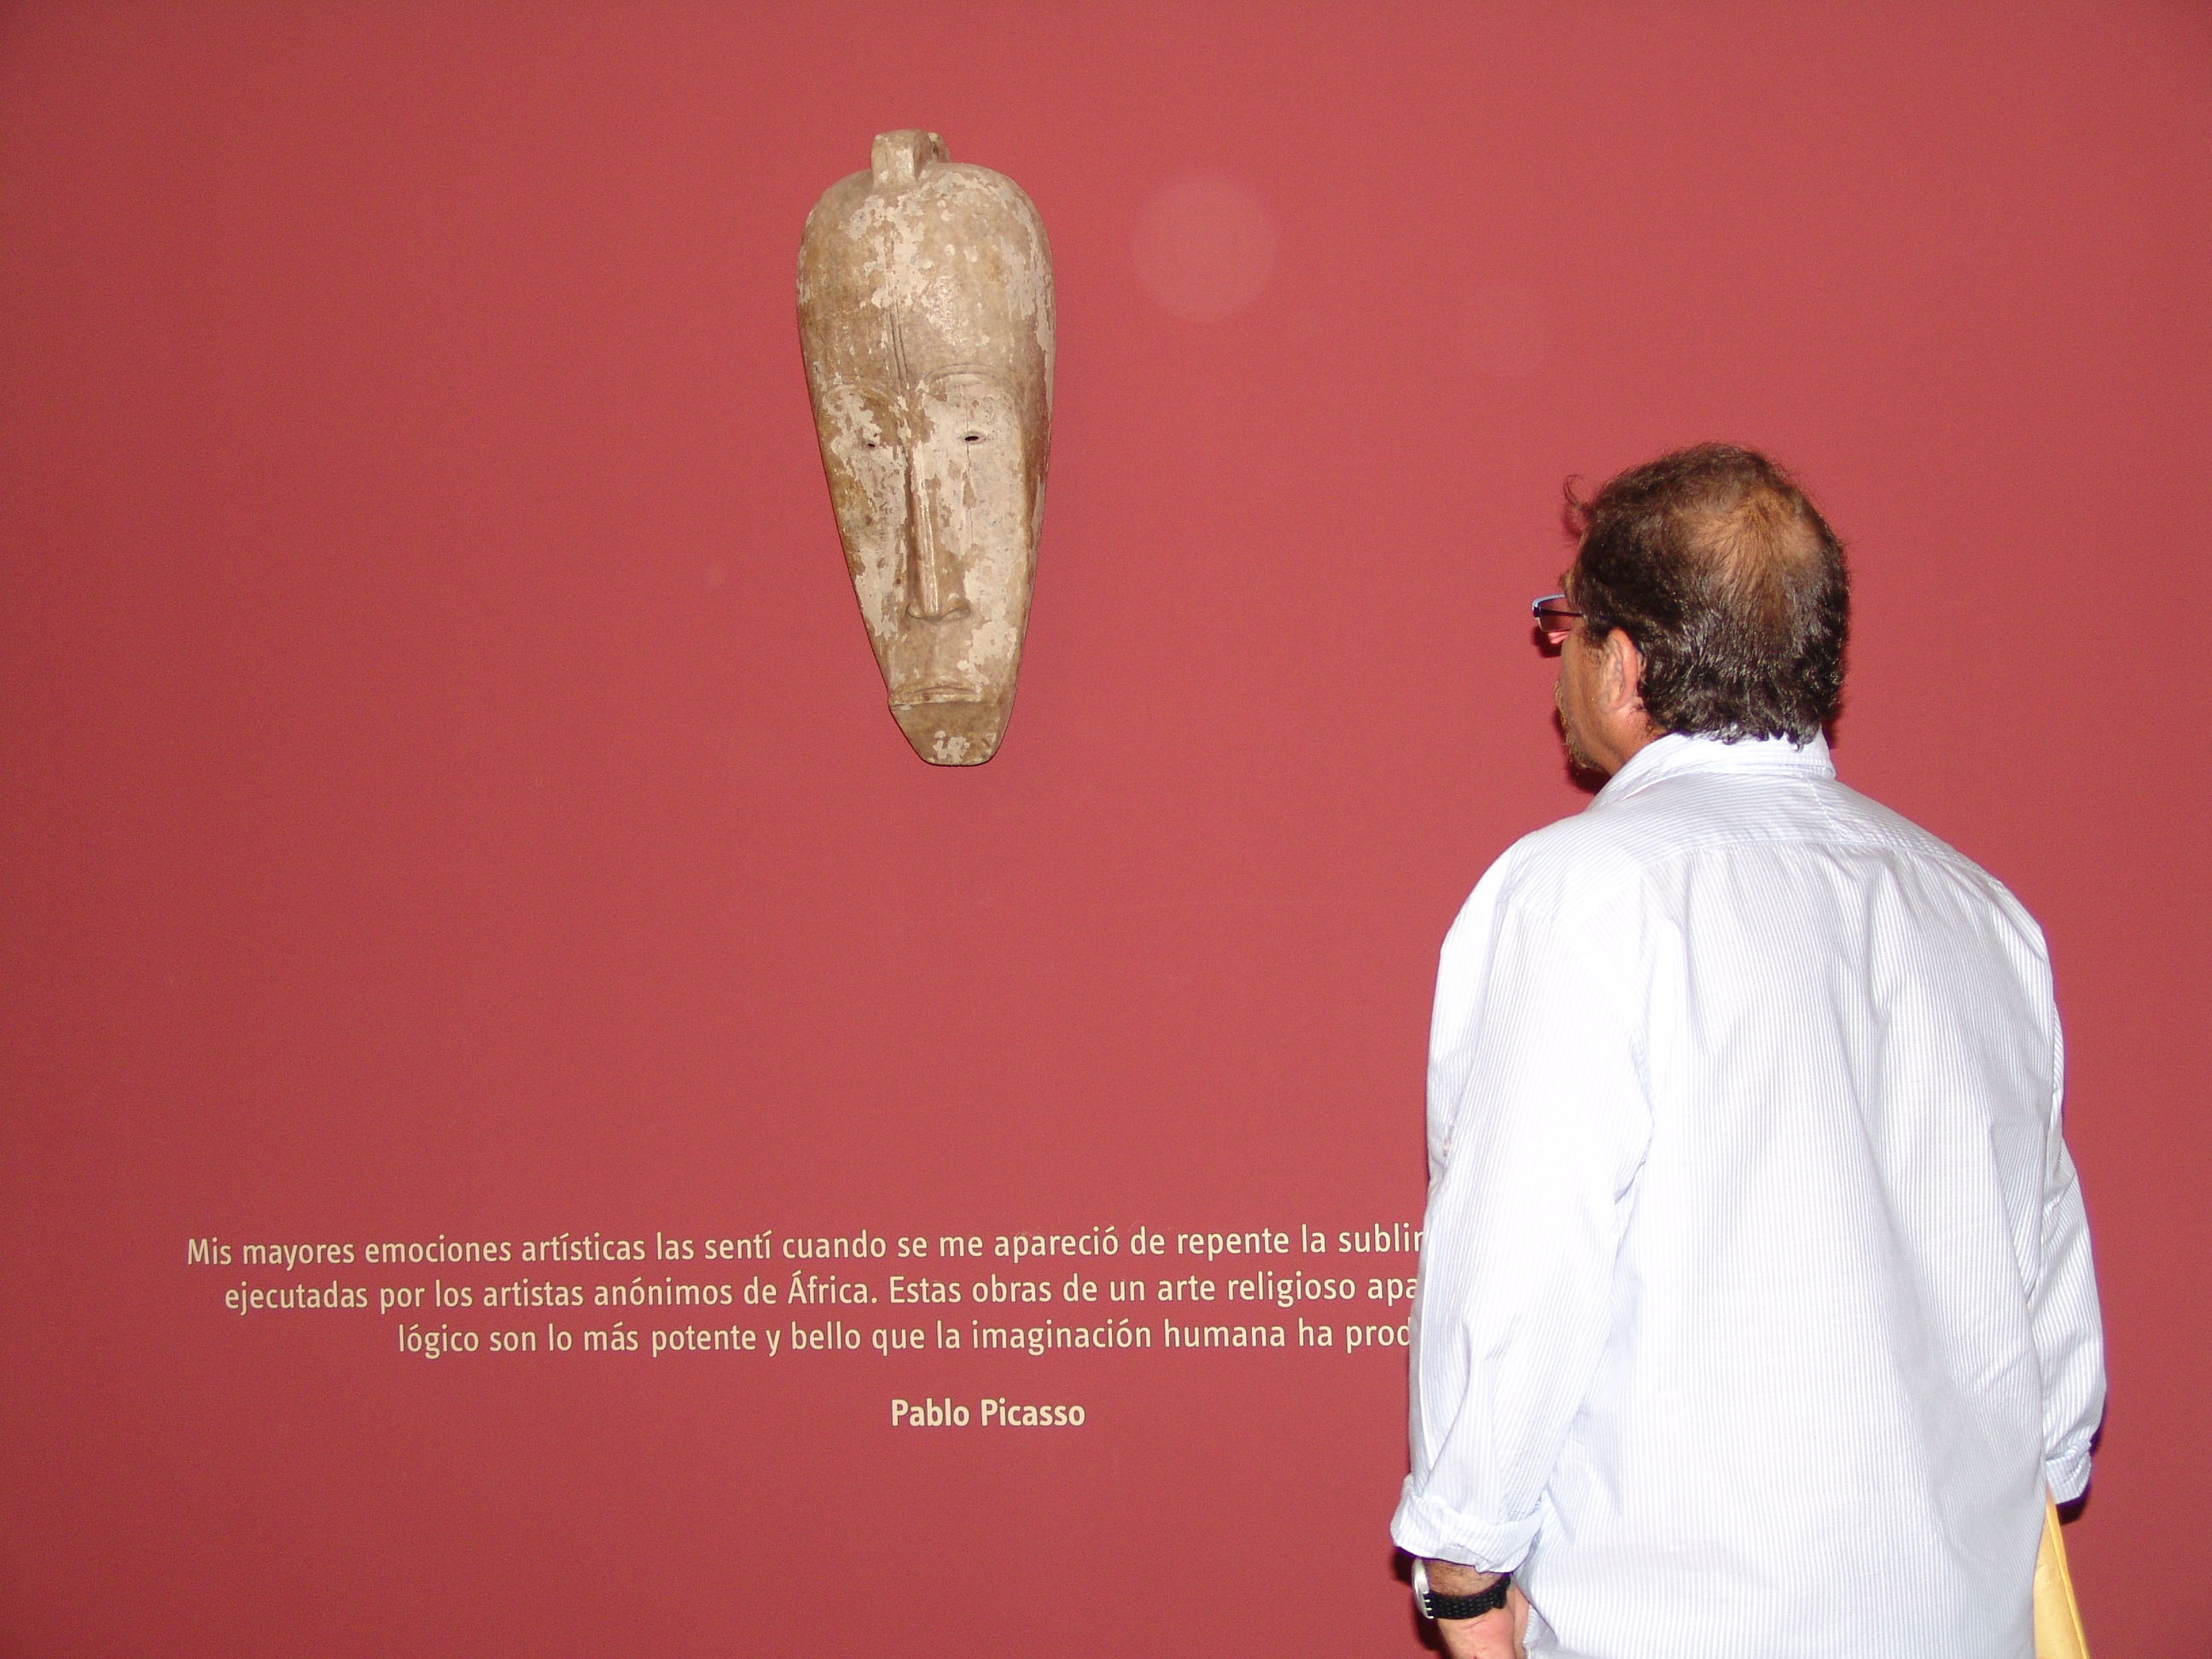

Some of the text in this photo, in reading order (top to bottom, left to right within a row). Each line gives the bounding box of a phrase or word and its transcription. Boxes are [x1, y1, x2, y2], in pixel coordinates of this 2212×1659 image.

[188, 1237, 232, 1265] Mis
[243, 1243, 355, 1272] mayores
[364, 1234, 511, 1263] emociones
[521, 1231, 646, 1262] artísticas
[656, 1231, 695, 1260] las
[704, 1229, 772, 1260] sentí
[783, 1229, 887, 1260] cuando
[897, 1237, 928, 1258] se
[939, 1236, 983, 1257] me
[994, 1225, 1119, 1264] apareció
[1130, 1225, 1165, 1255] de
[1177, 1227, 1289, 1262] repente
[1301, 1223, 1326, 1254] la
[224, 1280, 368, 1316] ejecutadas
[380, 1287, 426, 1315] por
[435, 1278, 473, 1307] los
[483, 1278, 584, 1307] artistas
[594, 1276, 733, 1306] anónimos
[743, 1275, 777, 1305] de
[787, 1269, 877, 1304] África.
[889, 1275, 962, 1304] Estas
[972, 1273, 1052, 1303] obras
[1062, 1272, 1097, 1302] de
[1109, 1280, 1145, 1301] un
[1157, 1274, 1216, 1301] arte
[1228, 1270, 1356, 1308] religioso
[399, 1323, 479, 1359] lógico
[489, 1331, 536, 1352] son
[548, 1323, 573, 1352] lo
[584, 1321, 638, 1351] más
[651, 1324, 757, 1359] potente
[765, 1330, 781, 1358] y
[791, 1320, 861, 1350] bello
[871, 1328, 925, 1357] que
[936, 1319, 961, 1349] la
[972, 1318, 1151, 1356] imaginación
[1164, 1318, 1285, 1348] humana
[1298, 1317, 1333, 1347] ha
[891, 1397, 1086, 1427] Pablo Picasso
